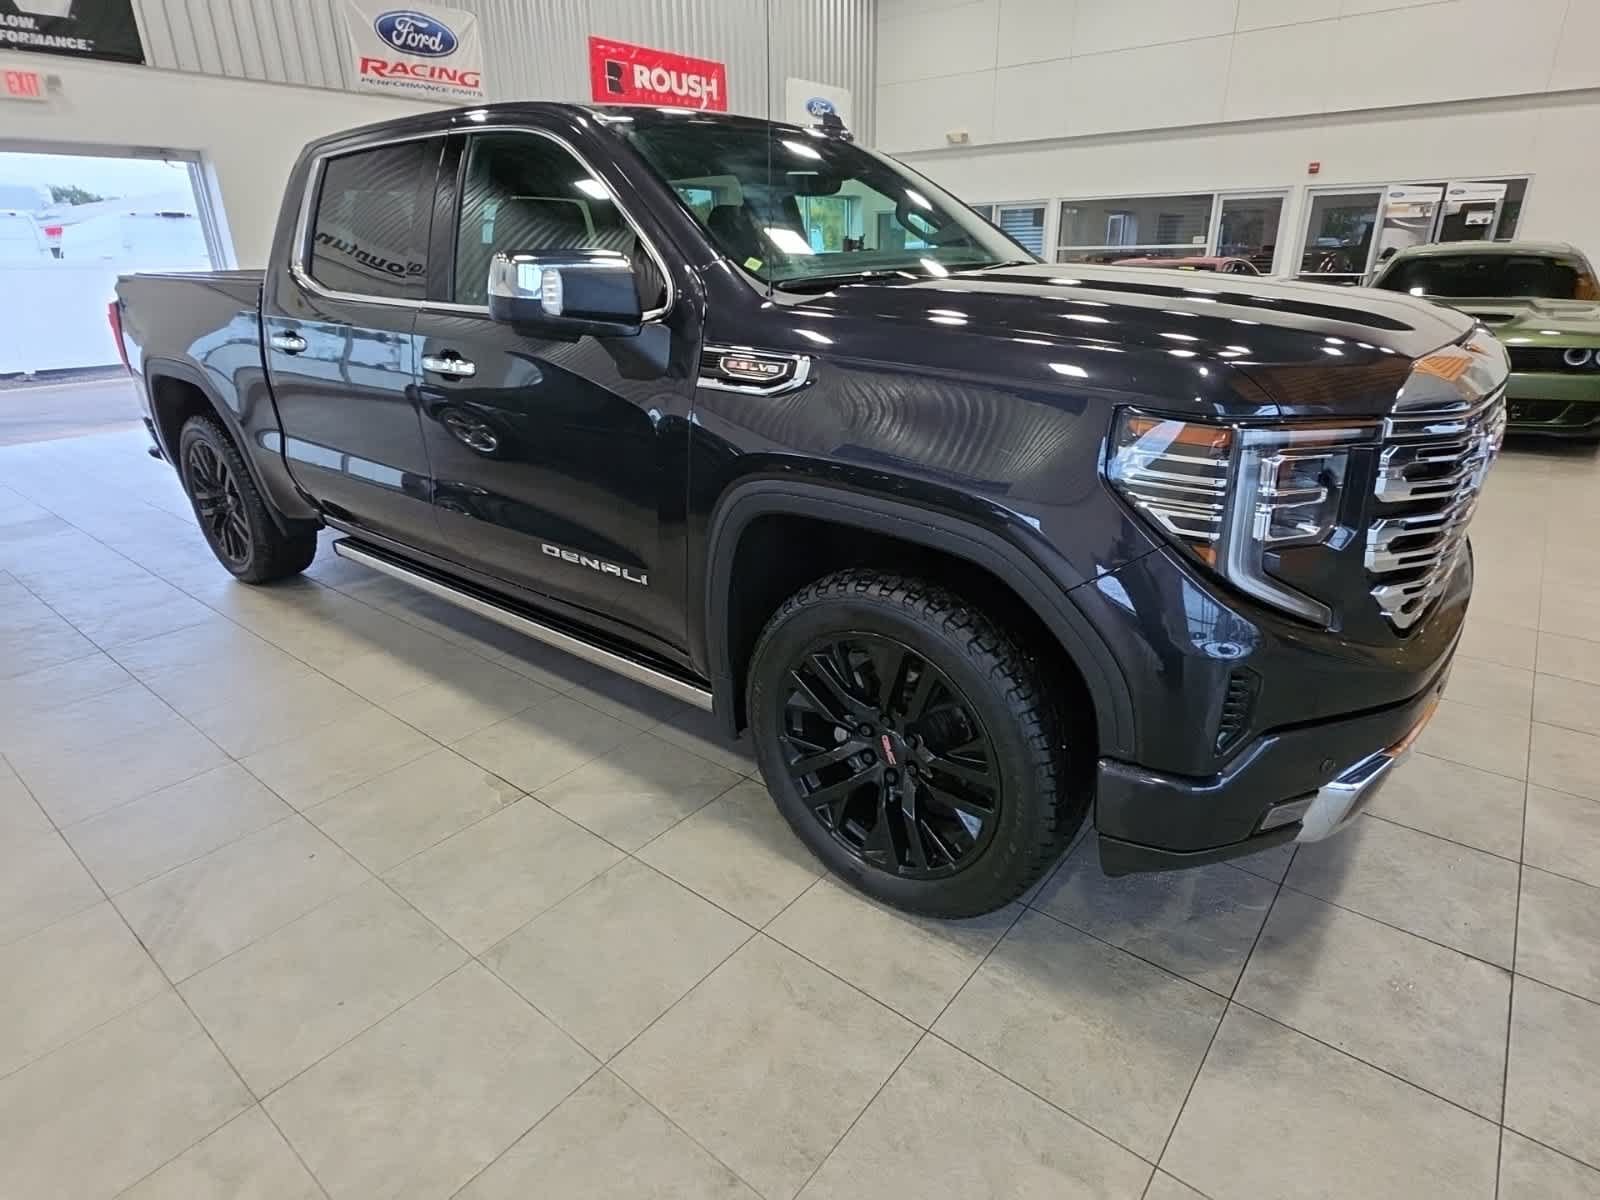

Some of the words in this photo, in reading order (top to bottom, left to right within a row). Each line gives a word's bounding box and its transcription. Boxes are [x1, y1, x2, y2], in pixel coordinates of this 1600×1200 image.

[392, 17, 443, 51] Ford
[5, 71, 40, 96] EXIT
[360, 57, 481, 88] RACING
[360, 77, 449, 93] PERFORMANCE
[452, 88, 484, 97] PARTS
[633, 63, 718, 101] ROUSH
[541, 543, 648, 585] DENALI
